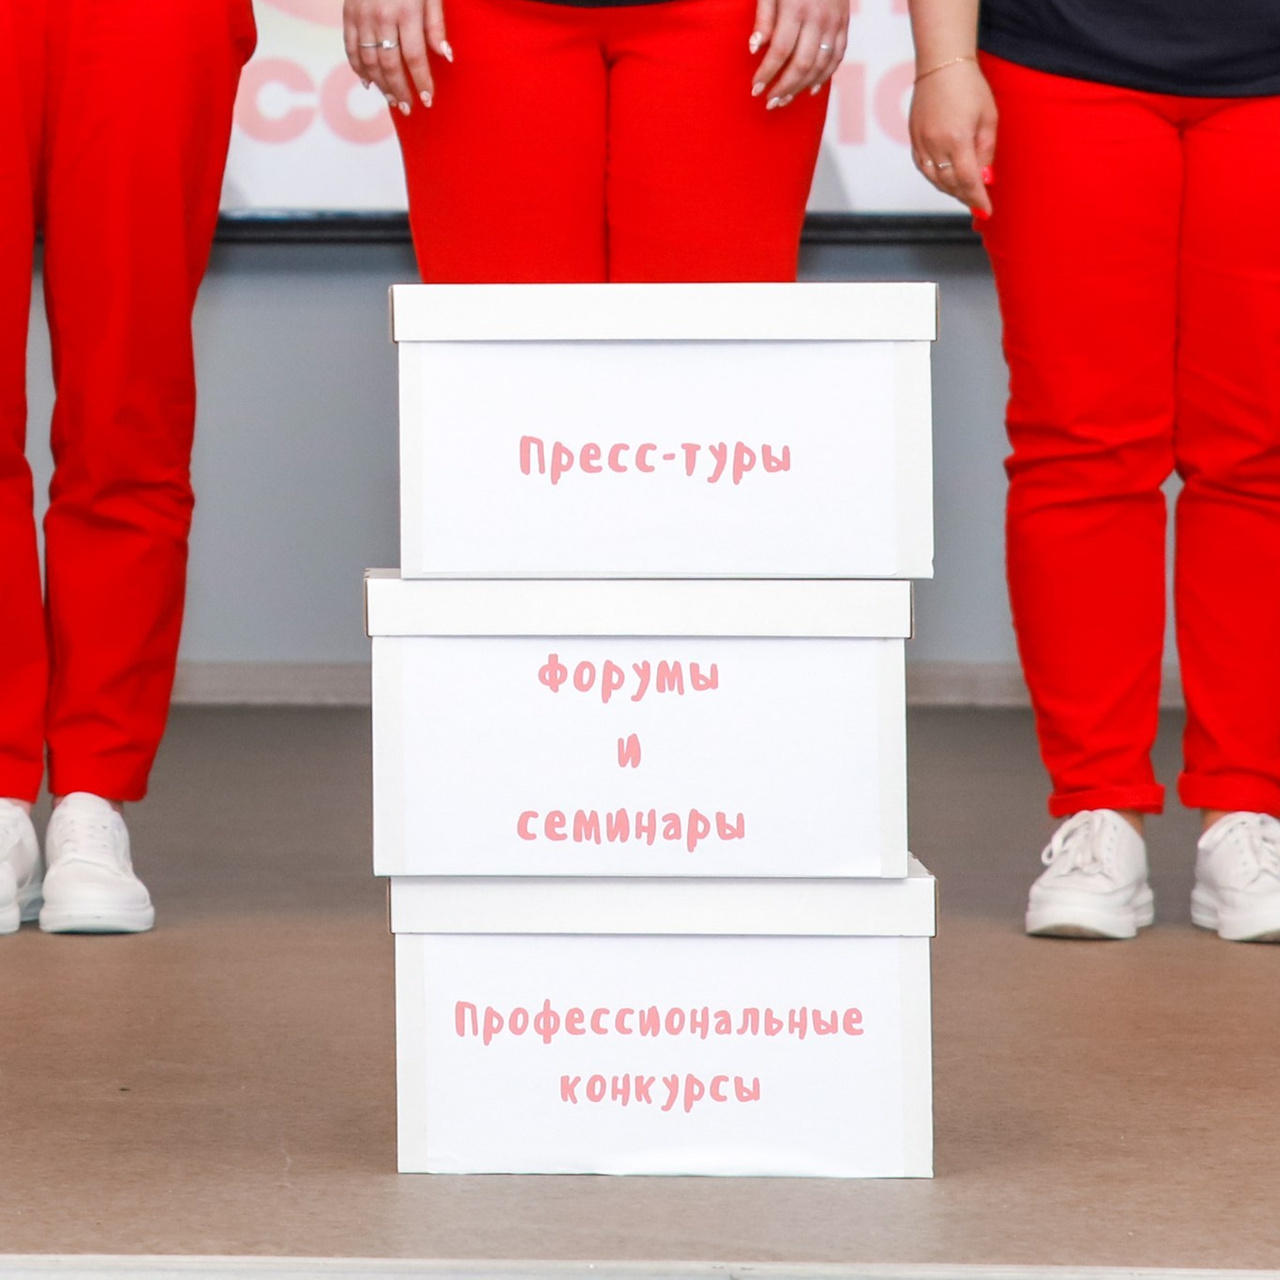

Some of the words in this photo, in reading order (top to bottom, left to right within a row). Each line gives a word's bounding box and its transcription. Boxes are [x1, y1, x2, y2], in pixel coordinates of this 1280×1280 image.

[519, 435, 791, 486] Пресс-туры
[516, 807, 746, 854] семинары
[454, 999, 865, 1046] Профессиональные
[560, 1073, 761, 1114] конкурсы
